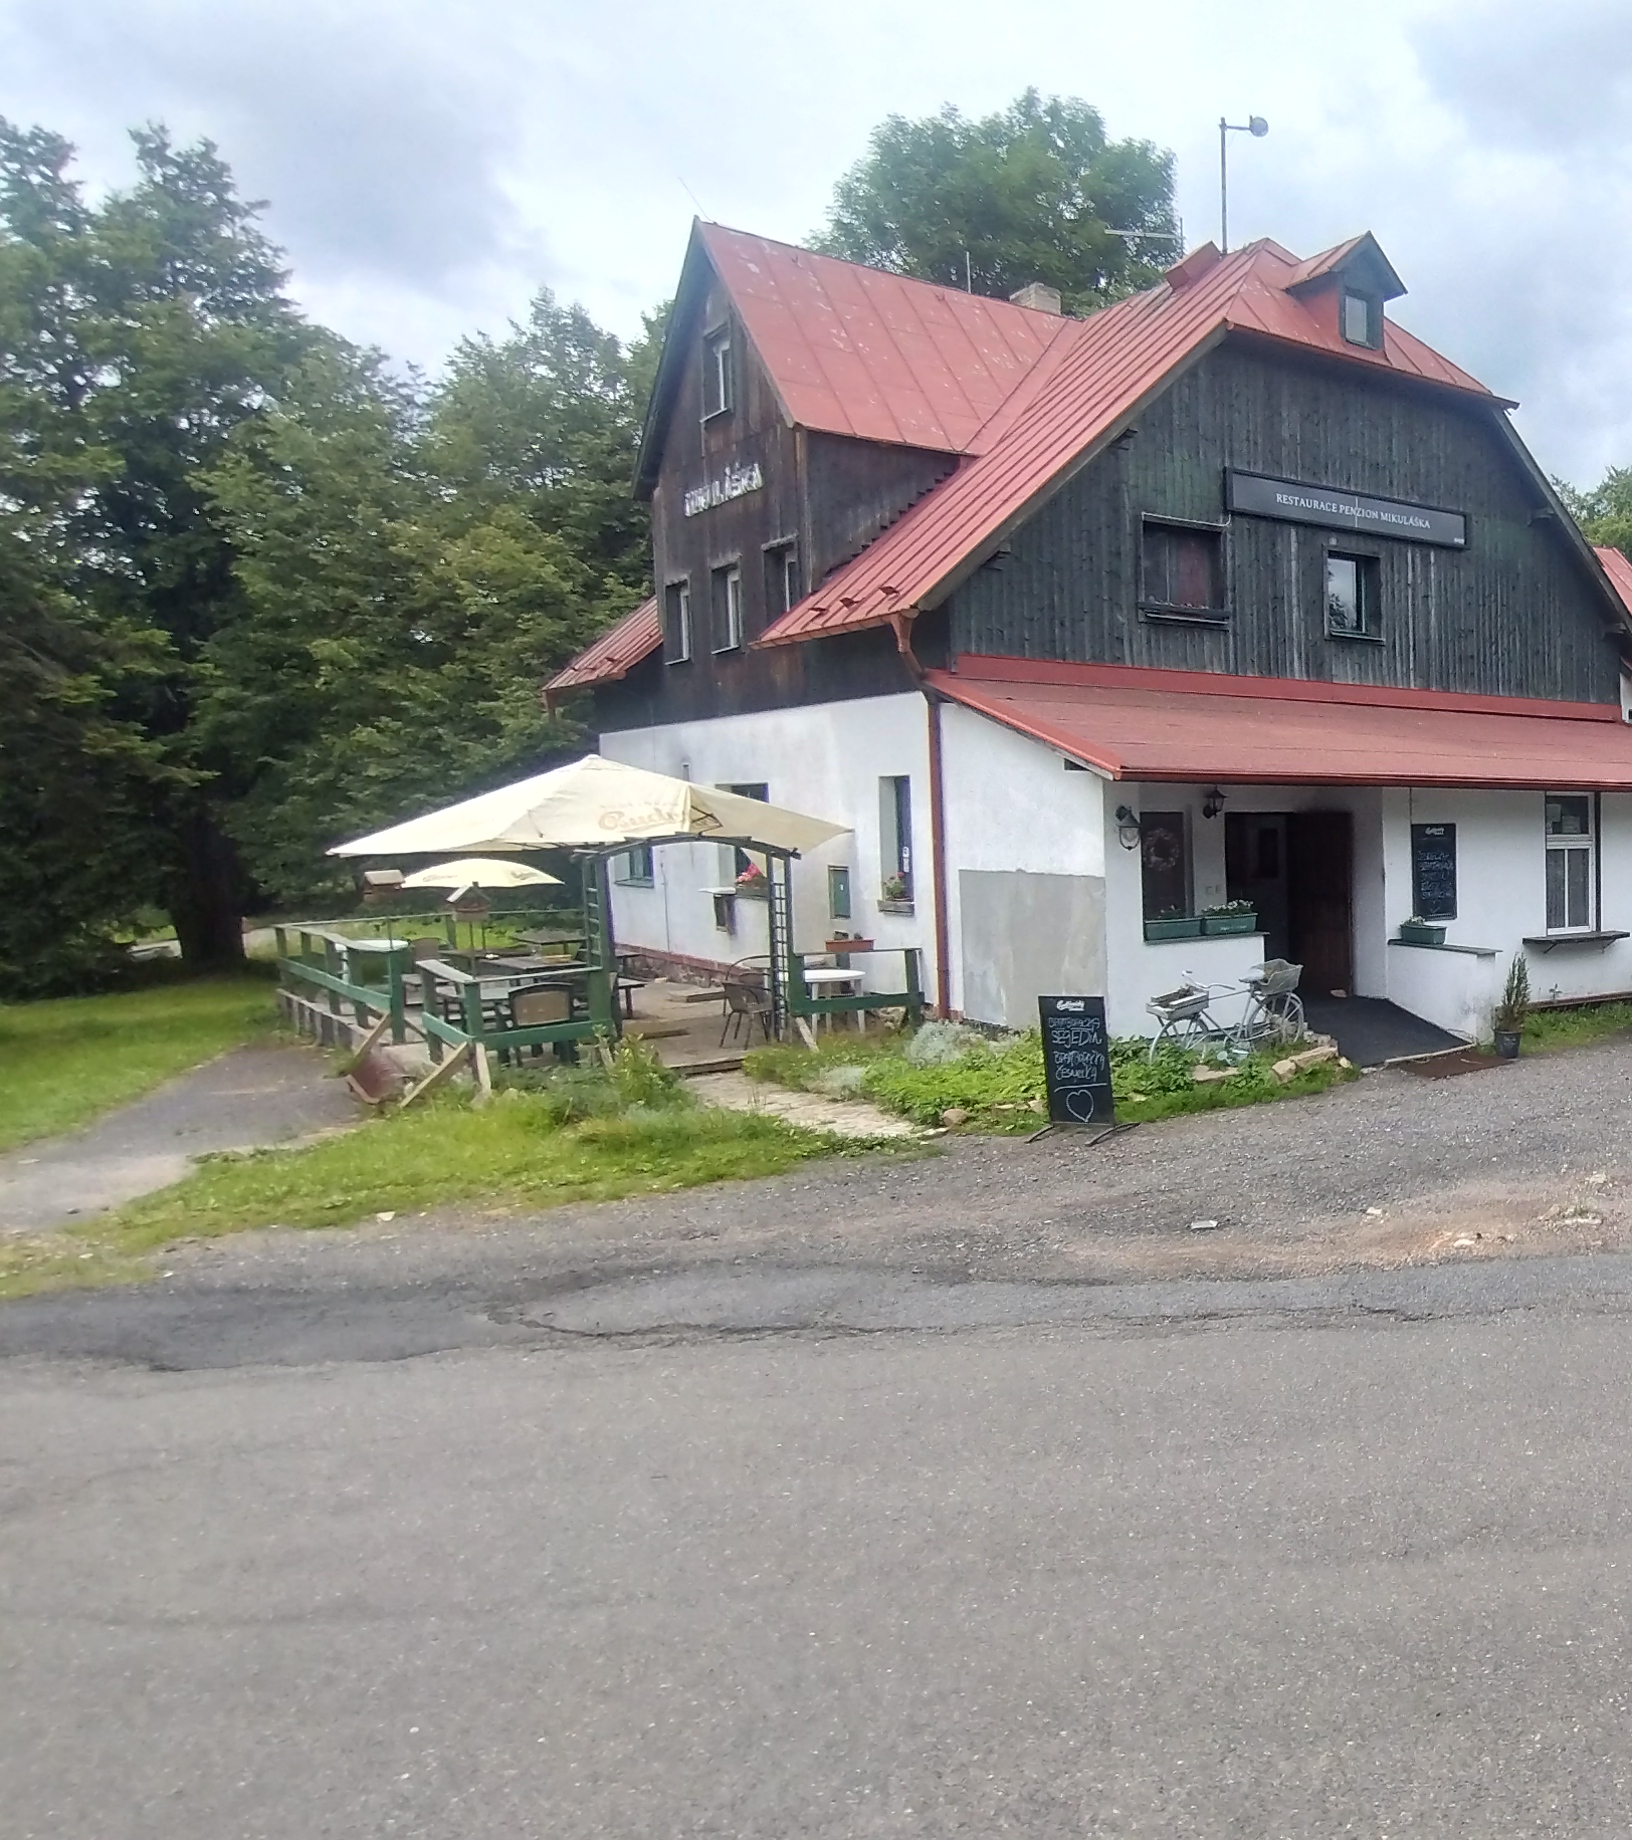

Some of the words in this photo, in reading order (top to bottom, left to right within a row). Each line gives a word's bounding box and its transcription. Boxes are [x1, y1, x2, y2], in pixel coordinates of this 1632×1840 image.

[1275, 493, 1337, 513] RESTAURACE
[1339, 504, 1379, 519] PENZION
[1380, 512, 1431, 529] MIKULÁŠKA
